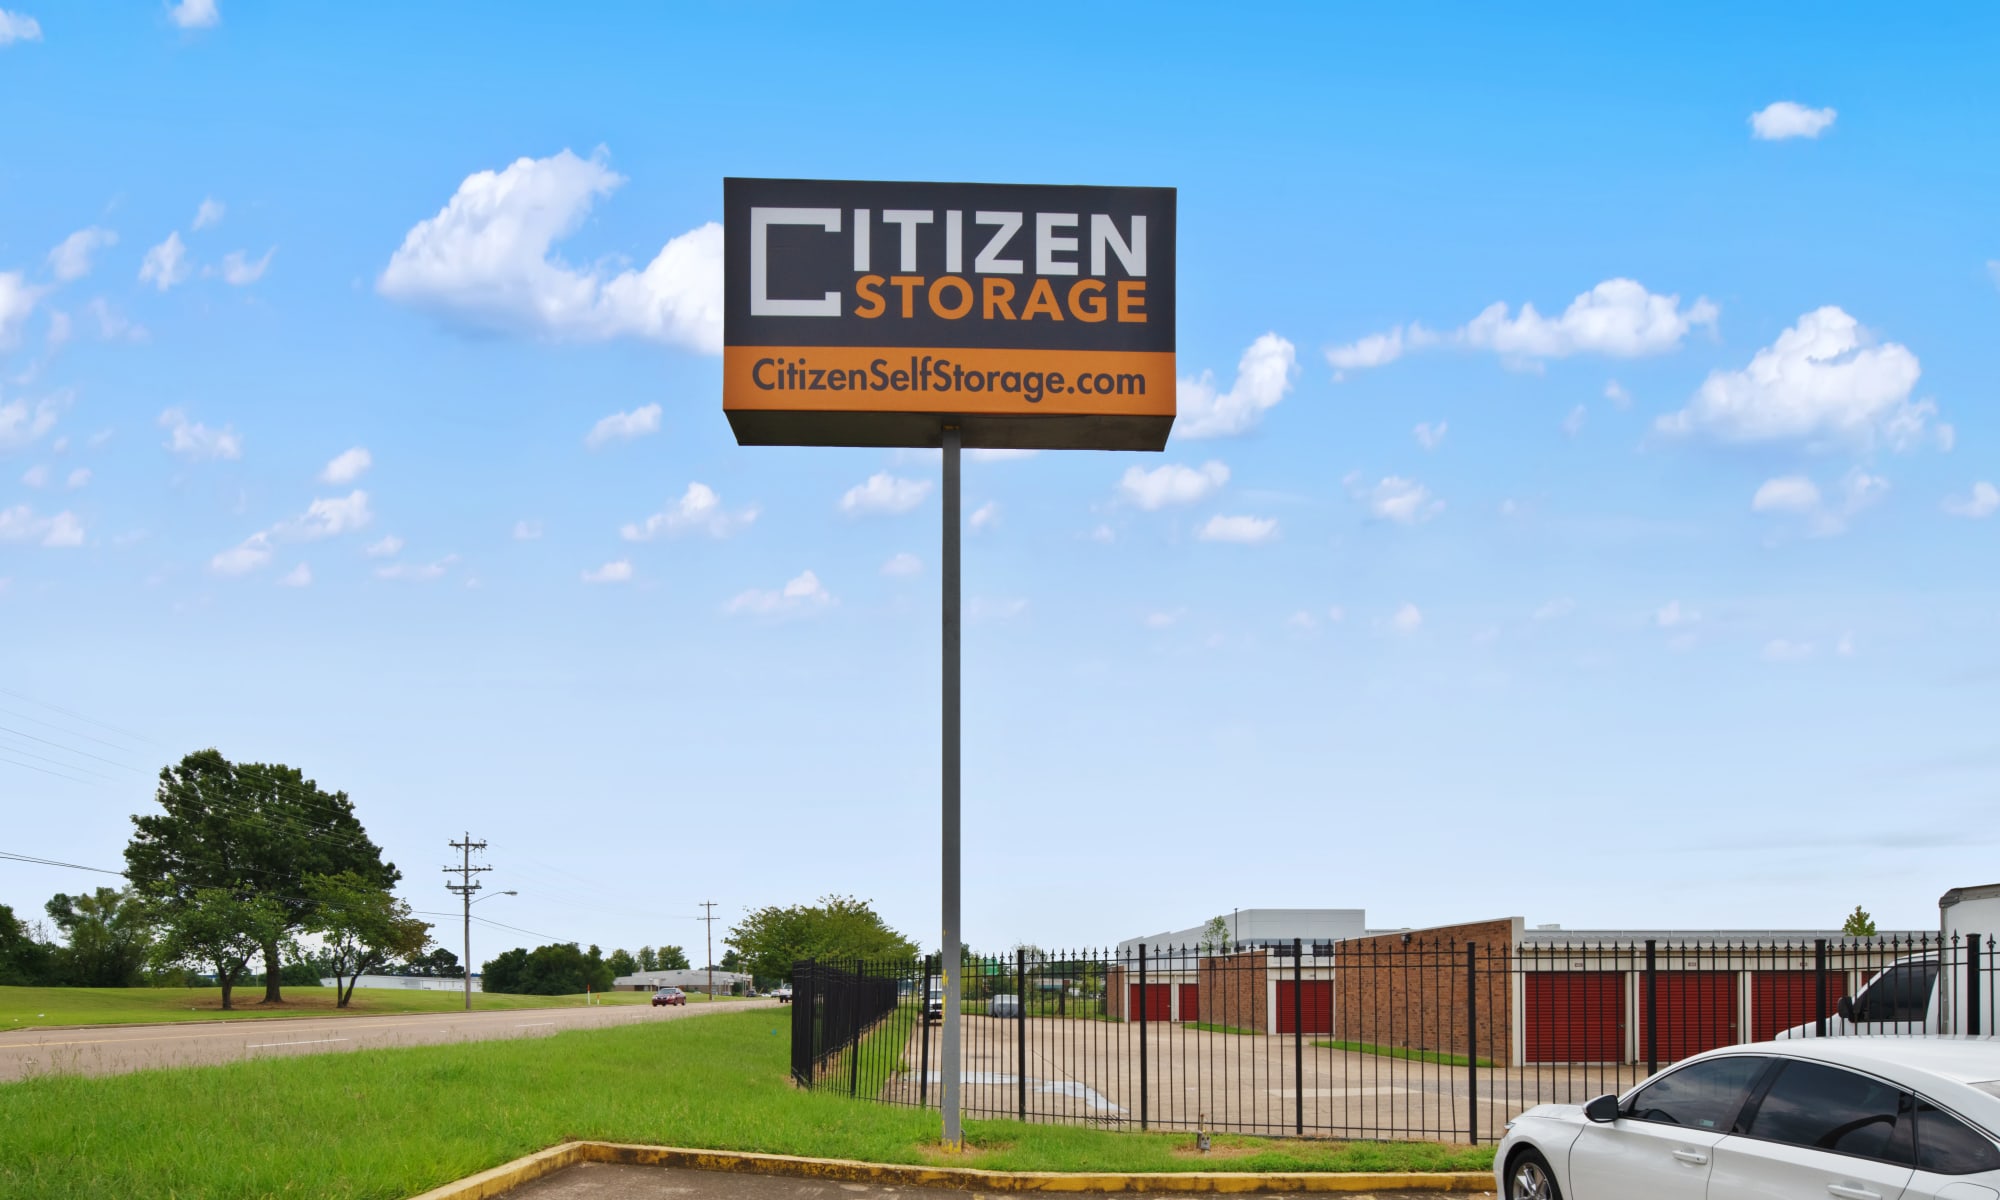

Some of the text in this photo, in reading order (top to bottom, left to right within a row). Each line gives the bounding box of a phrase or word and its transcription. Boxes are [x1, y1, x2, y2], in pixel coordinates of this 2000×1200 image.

[751, 207, 1147, 317] CITIZEN
[854, 275, 1147, 323] STORAGE
[752, 356, 1146, 403] CitizenSelfStorage.com
